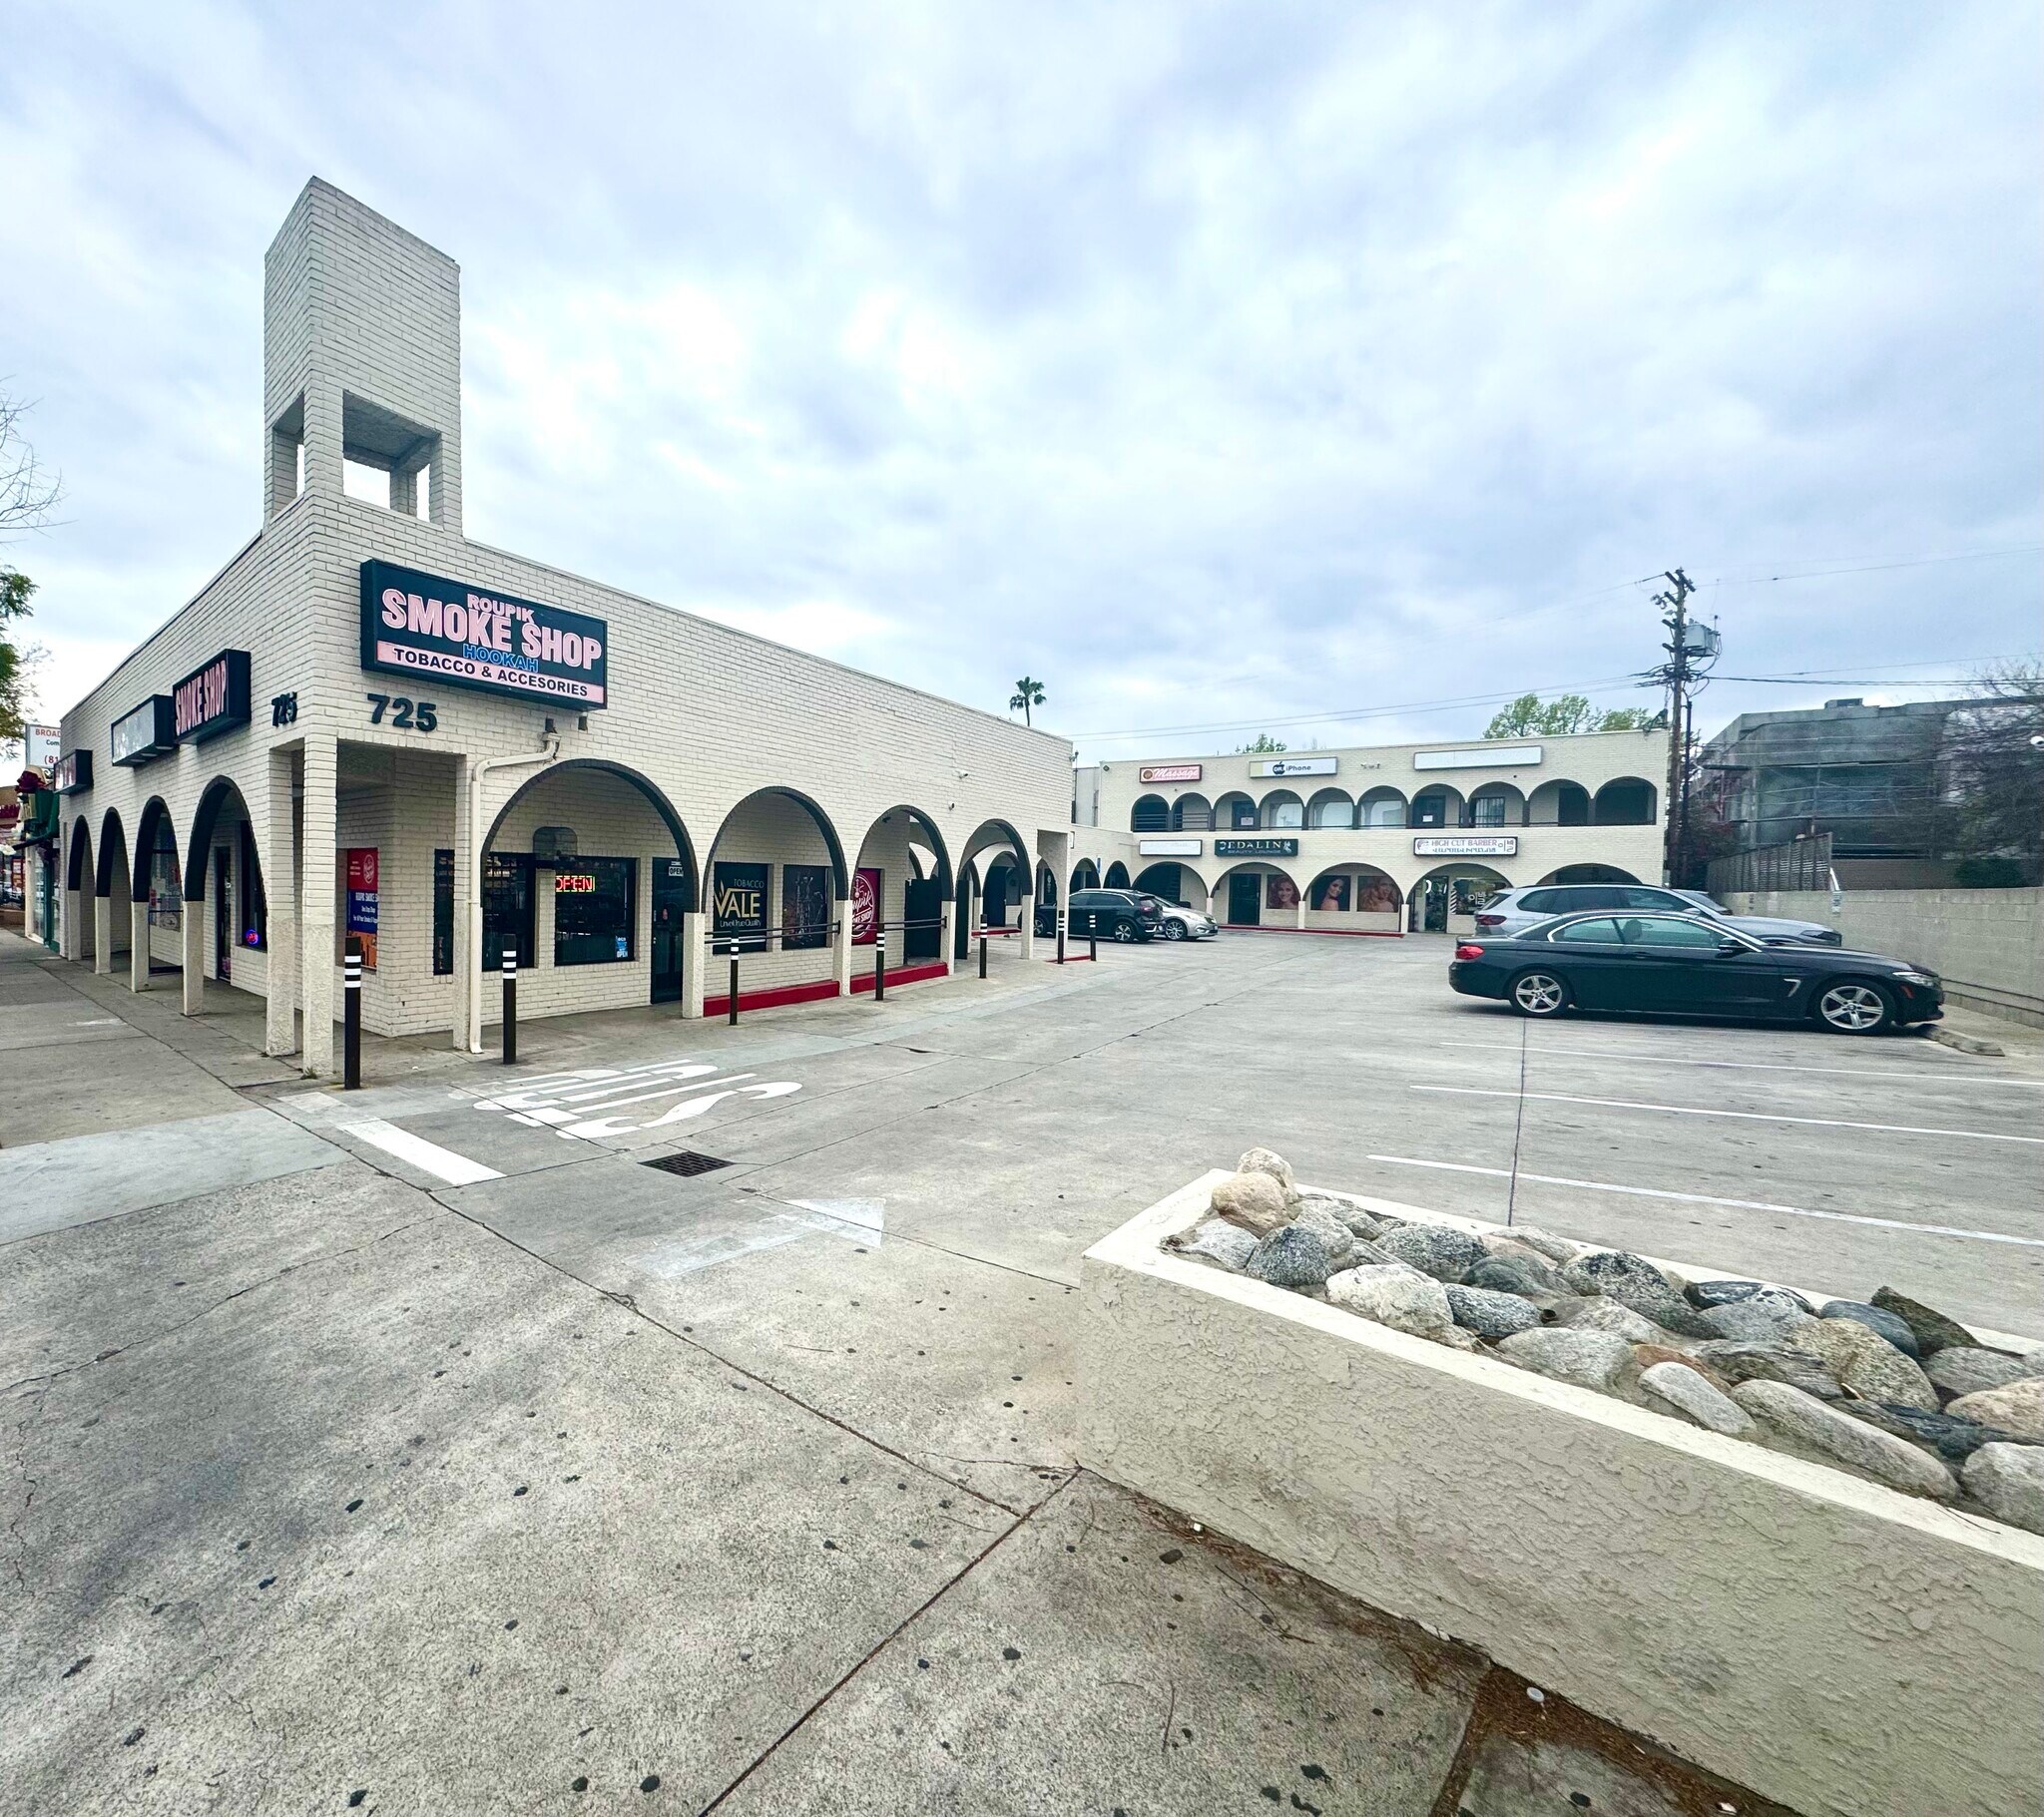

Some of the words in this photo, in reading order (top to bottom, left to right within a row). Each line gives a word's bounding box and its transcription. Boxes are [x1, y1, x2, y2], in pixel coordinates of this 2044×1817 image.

[467, 594, 535, 624] ROUPIK
[382, 588, 512, 653] SMOKE
[522, 623, 602, 670] SHOP
[393, 648, 476, 676] TOBACCO
[481, 666, 492, 679] &
[497, 669, 588, 696] ACCESORIES
[462, 643, 539, 674] HOOKAH
[176, 676, 203, 736] SMOKE
[204, 660, 227, 722] SHOP
[271, 690, 298, 727] 725
[367, 692, 438, 732] 725
[1153, 767, 1199, 779] Massage
[734, 879, 765, 888] TOBACCO
[714, 887, 761, 918] VALE
